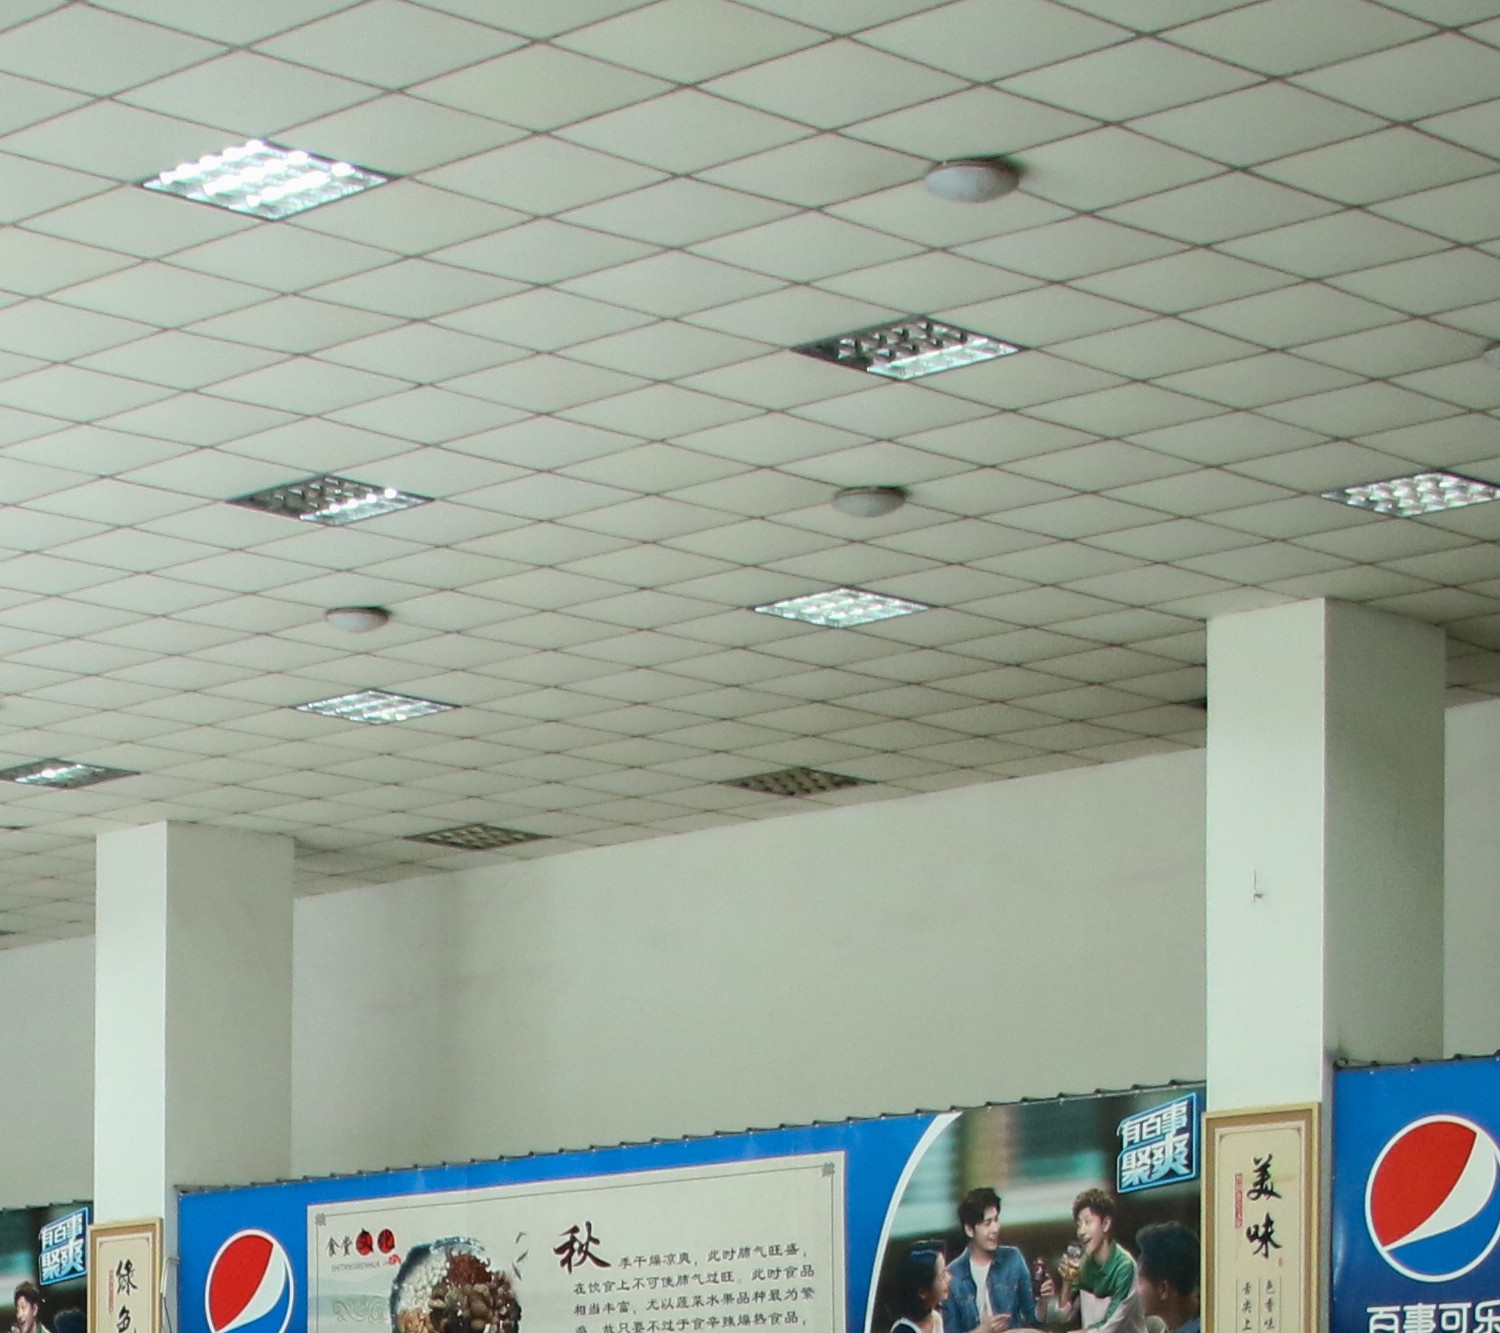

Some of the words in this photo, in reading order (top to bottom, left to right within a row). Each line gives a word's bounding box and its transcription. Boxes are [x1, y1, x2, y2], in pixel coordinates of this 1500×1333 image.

[1120, 1099, 1186, 1150] 有百事
[1119, 1134, 1192, 1184] 聚爽
[1246, 1153, 1282, 1260] 美味
[553, 1221, 611, 1274] 秋
